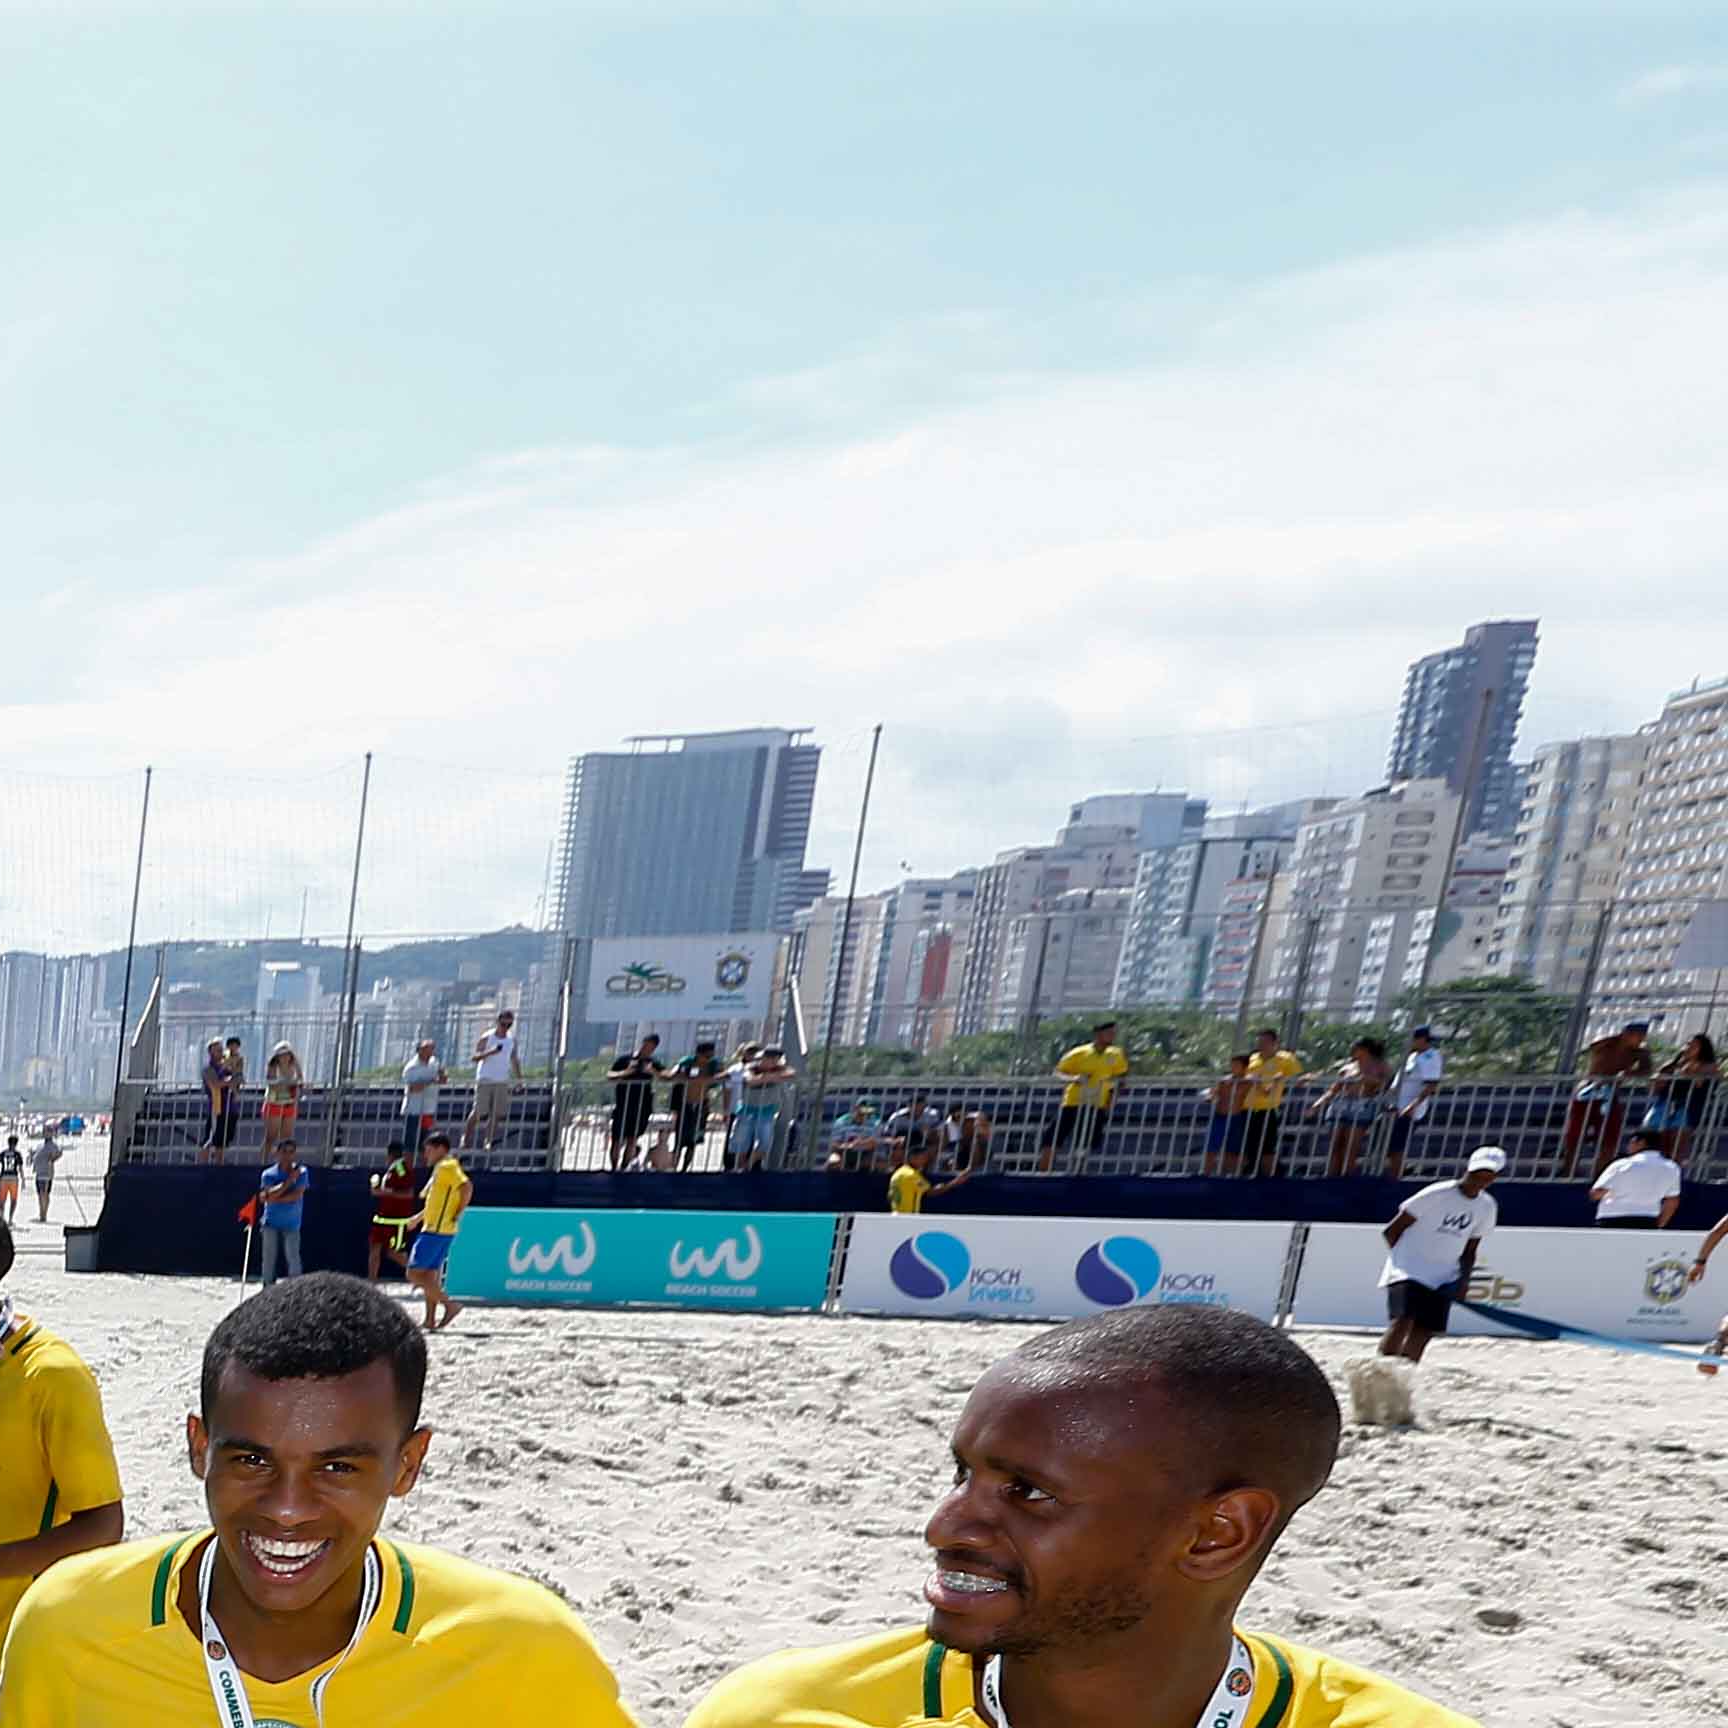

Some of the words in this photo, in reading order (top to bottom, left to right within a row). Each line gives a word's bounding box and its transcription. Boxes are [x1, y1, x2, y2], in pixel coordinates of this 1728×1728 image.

[970, 1269, 1020, 1285] KOCH
[1160, 1274, 1215, 1291] KOCH
[505, 1279, 545, 1290] BEACH
[547, 1280, 592, 1292] SOCCER
[665, 1283, 706, 1295] BEACH
[709, 1285, 757, 1297] SOCCER
